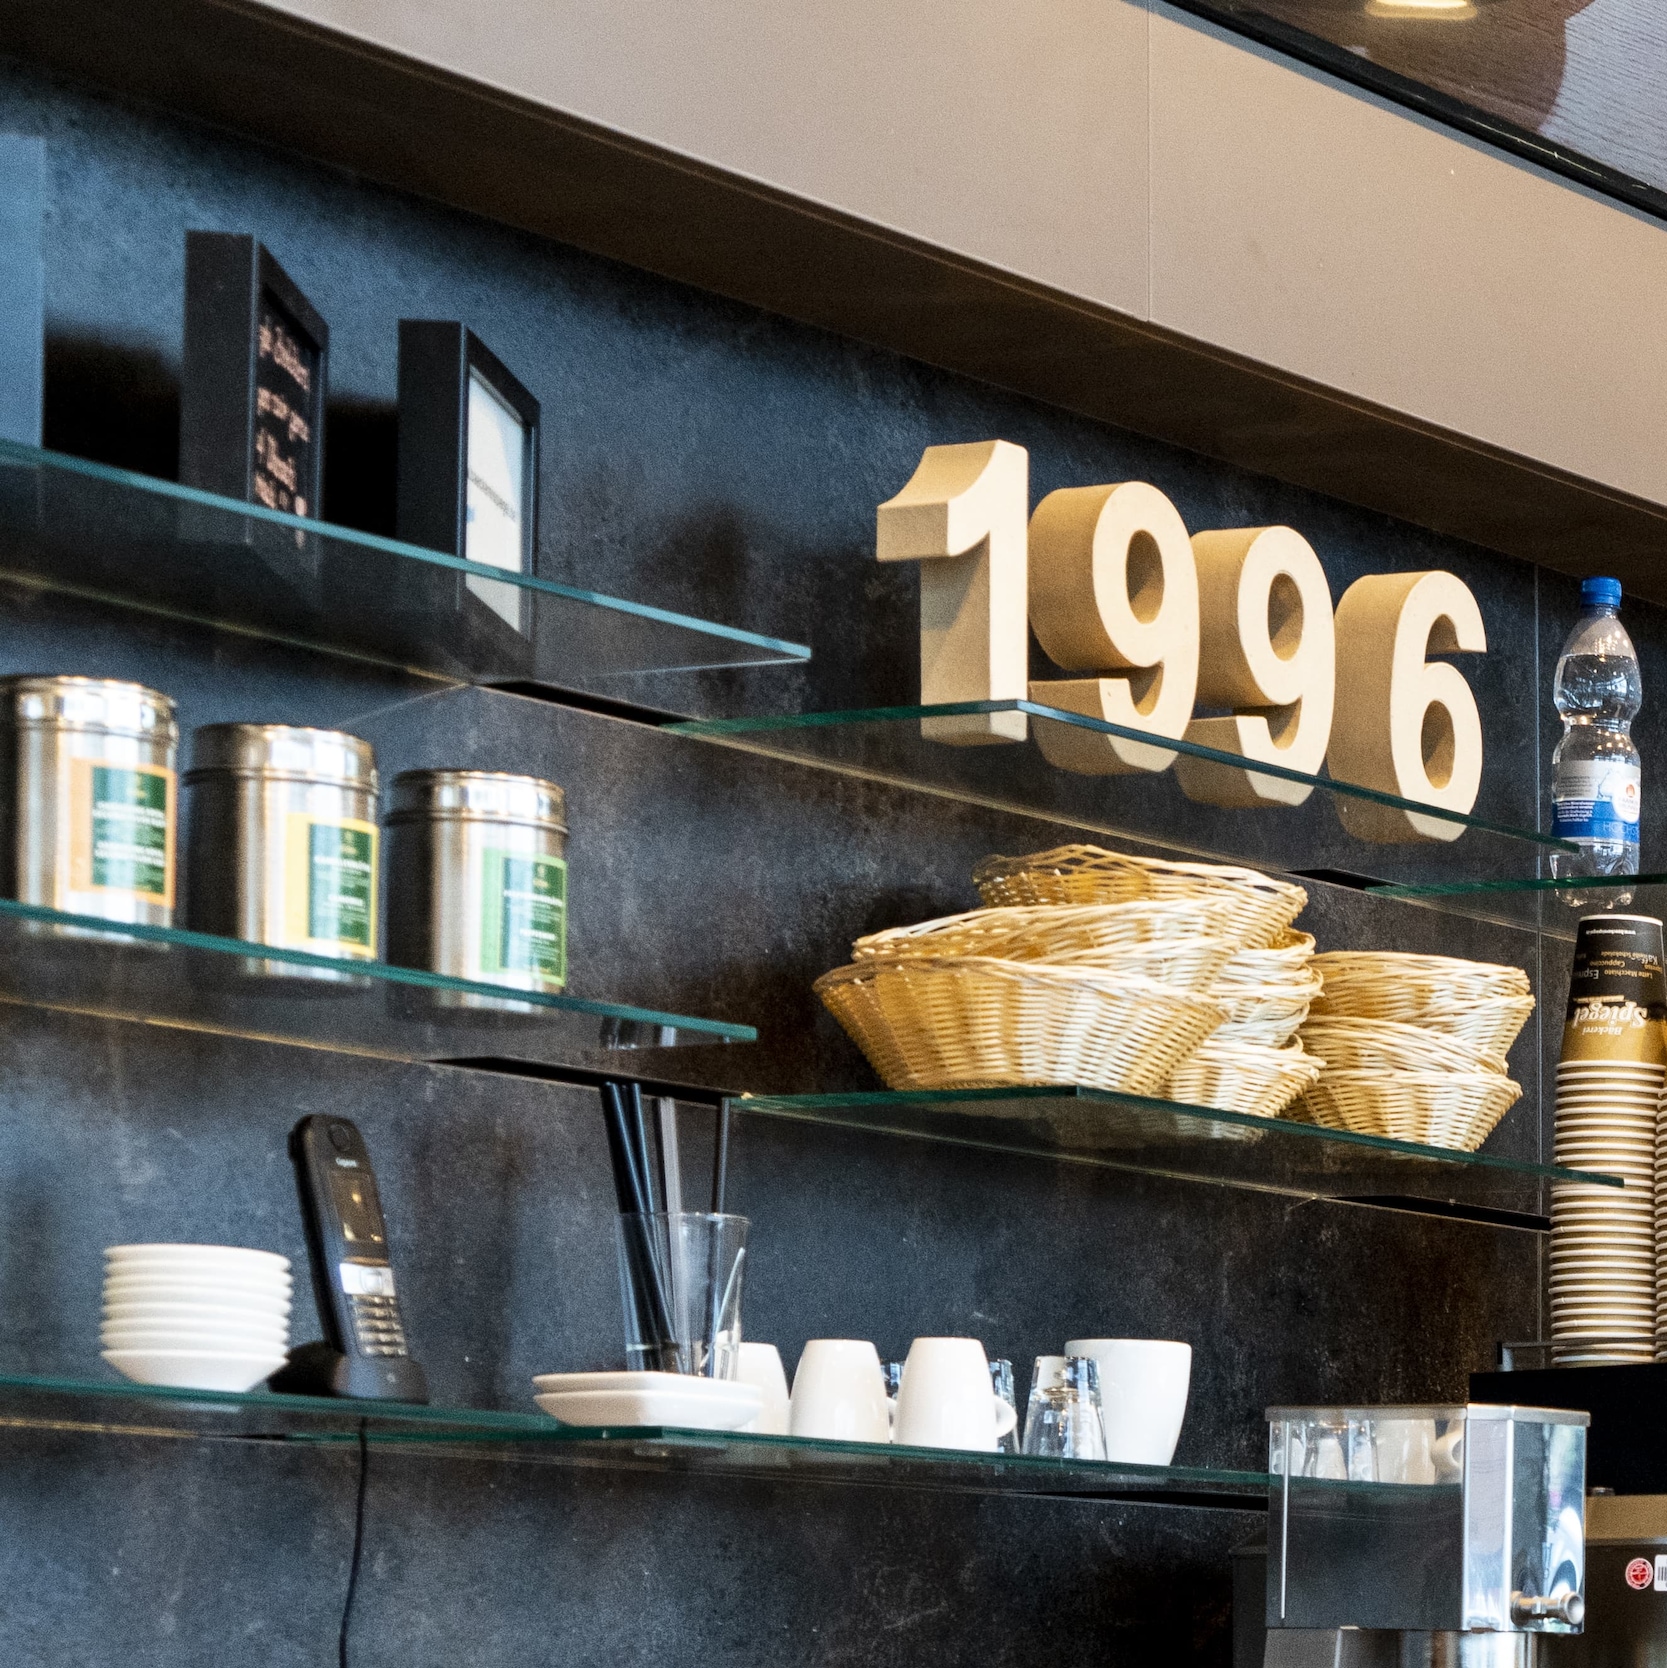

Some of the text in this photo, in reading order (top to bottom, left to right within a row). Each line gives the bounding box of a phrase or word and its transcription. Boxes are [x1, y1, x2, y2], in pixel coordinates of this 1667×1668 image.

[877, 439, 1487, 844] 1996
[1572, 1001, 1648, 1029] Spiegel
[1582, 1026, 1623, 1036] Bäckerei
